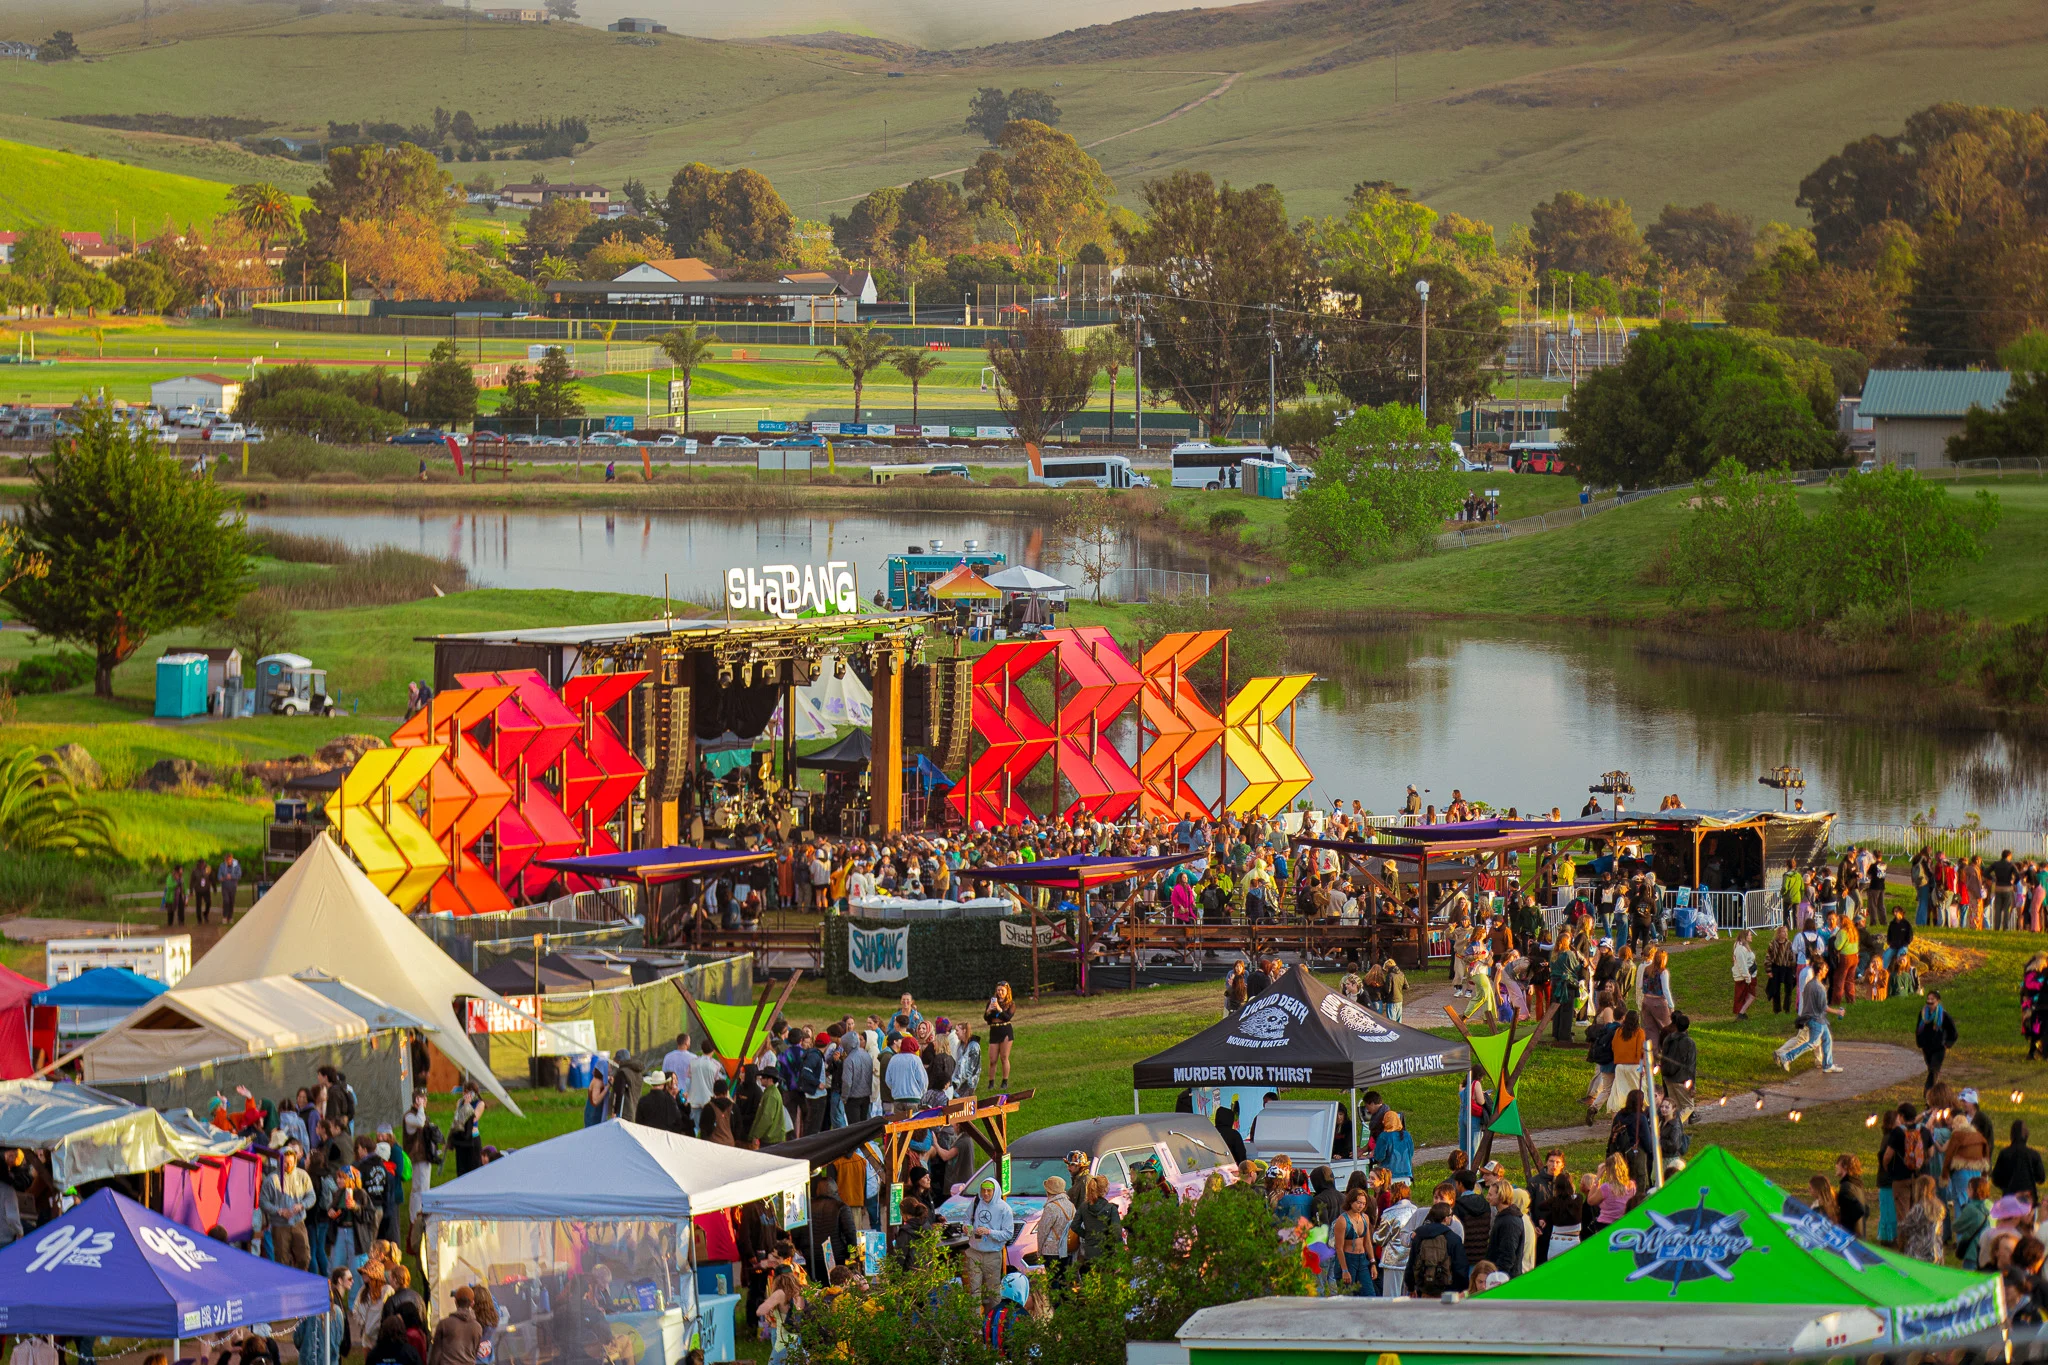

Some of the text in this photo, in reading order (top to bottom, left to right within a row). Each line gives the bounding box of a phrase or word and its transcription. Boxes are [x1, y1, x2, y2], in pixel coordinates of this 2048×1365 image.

[852, 930, 903, 973] SHABANG
[1239, 993, 1280, 1021] LIQUID
[1278, 994, 1309, 1025] DEATH
[485, 1014, 523, 1033] TENT
[1226, 1035, 1290, 1049] MOUNTAIN WATER
[1173, 1065, 1313, 1084] MURDER YOUR THIRST
[1381, 1054, 1444, 1078] DEATH TO PLASTIC
[1656, 1244, 1727, 1261] EATS
